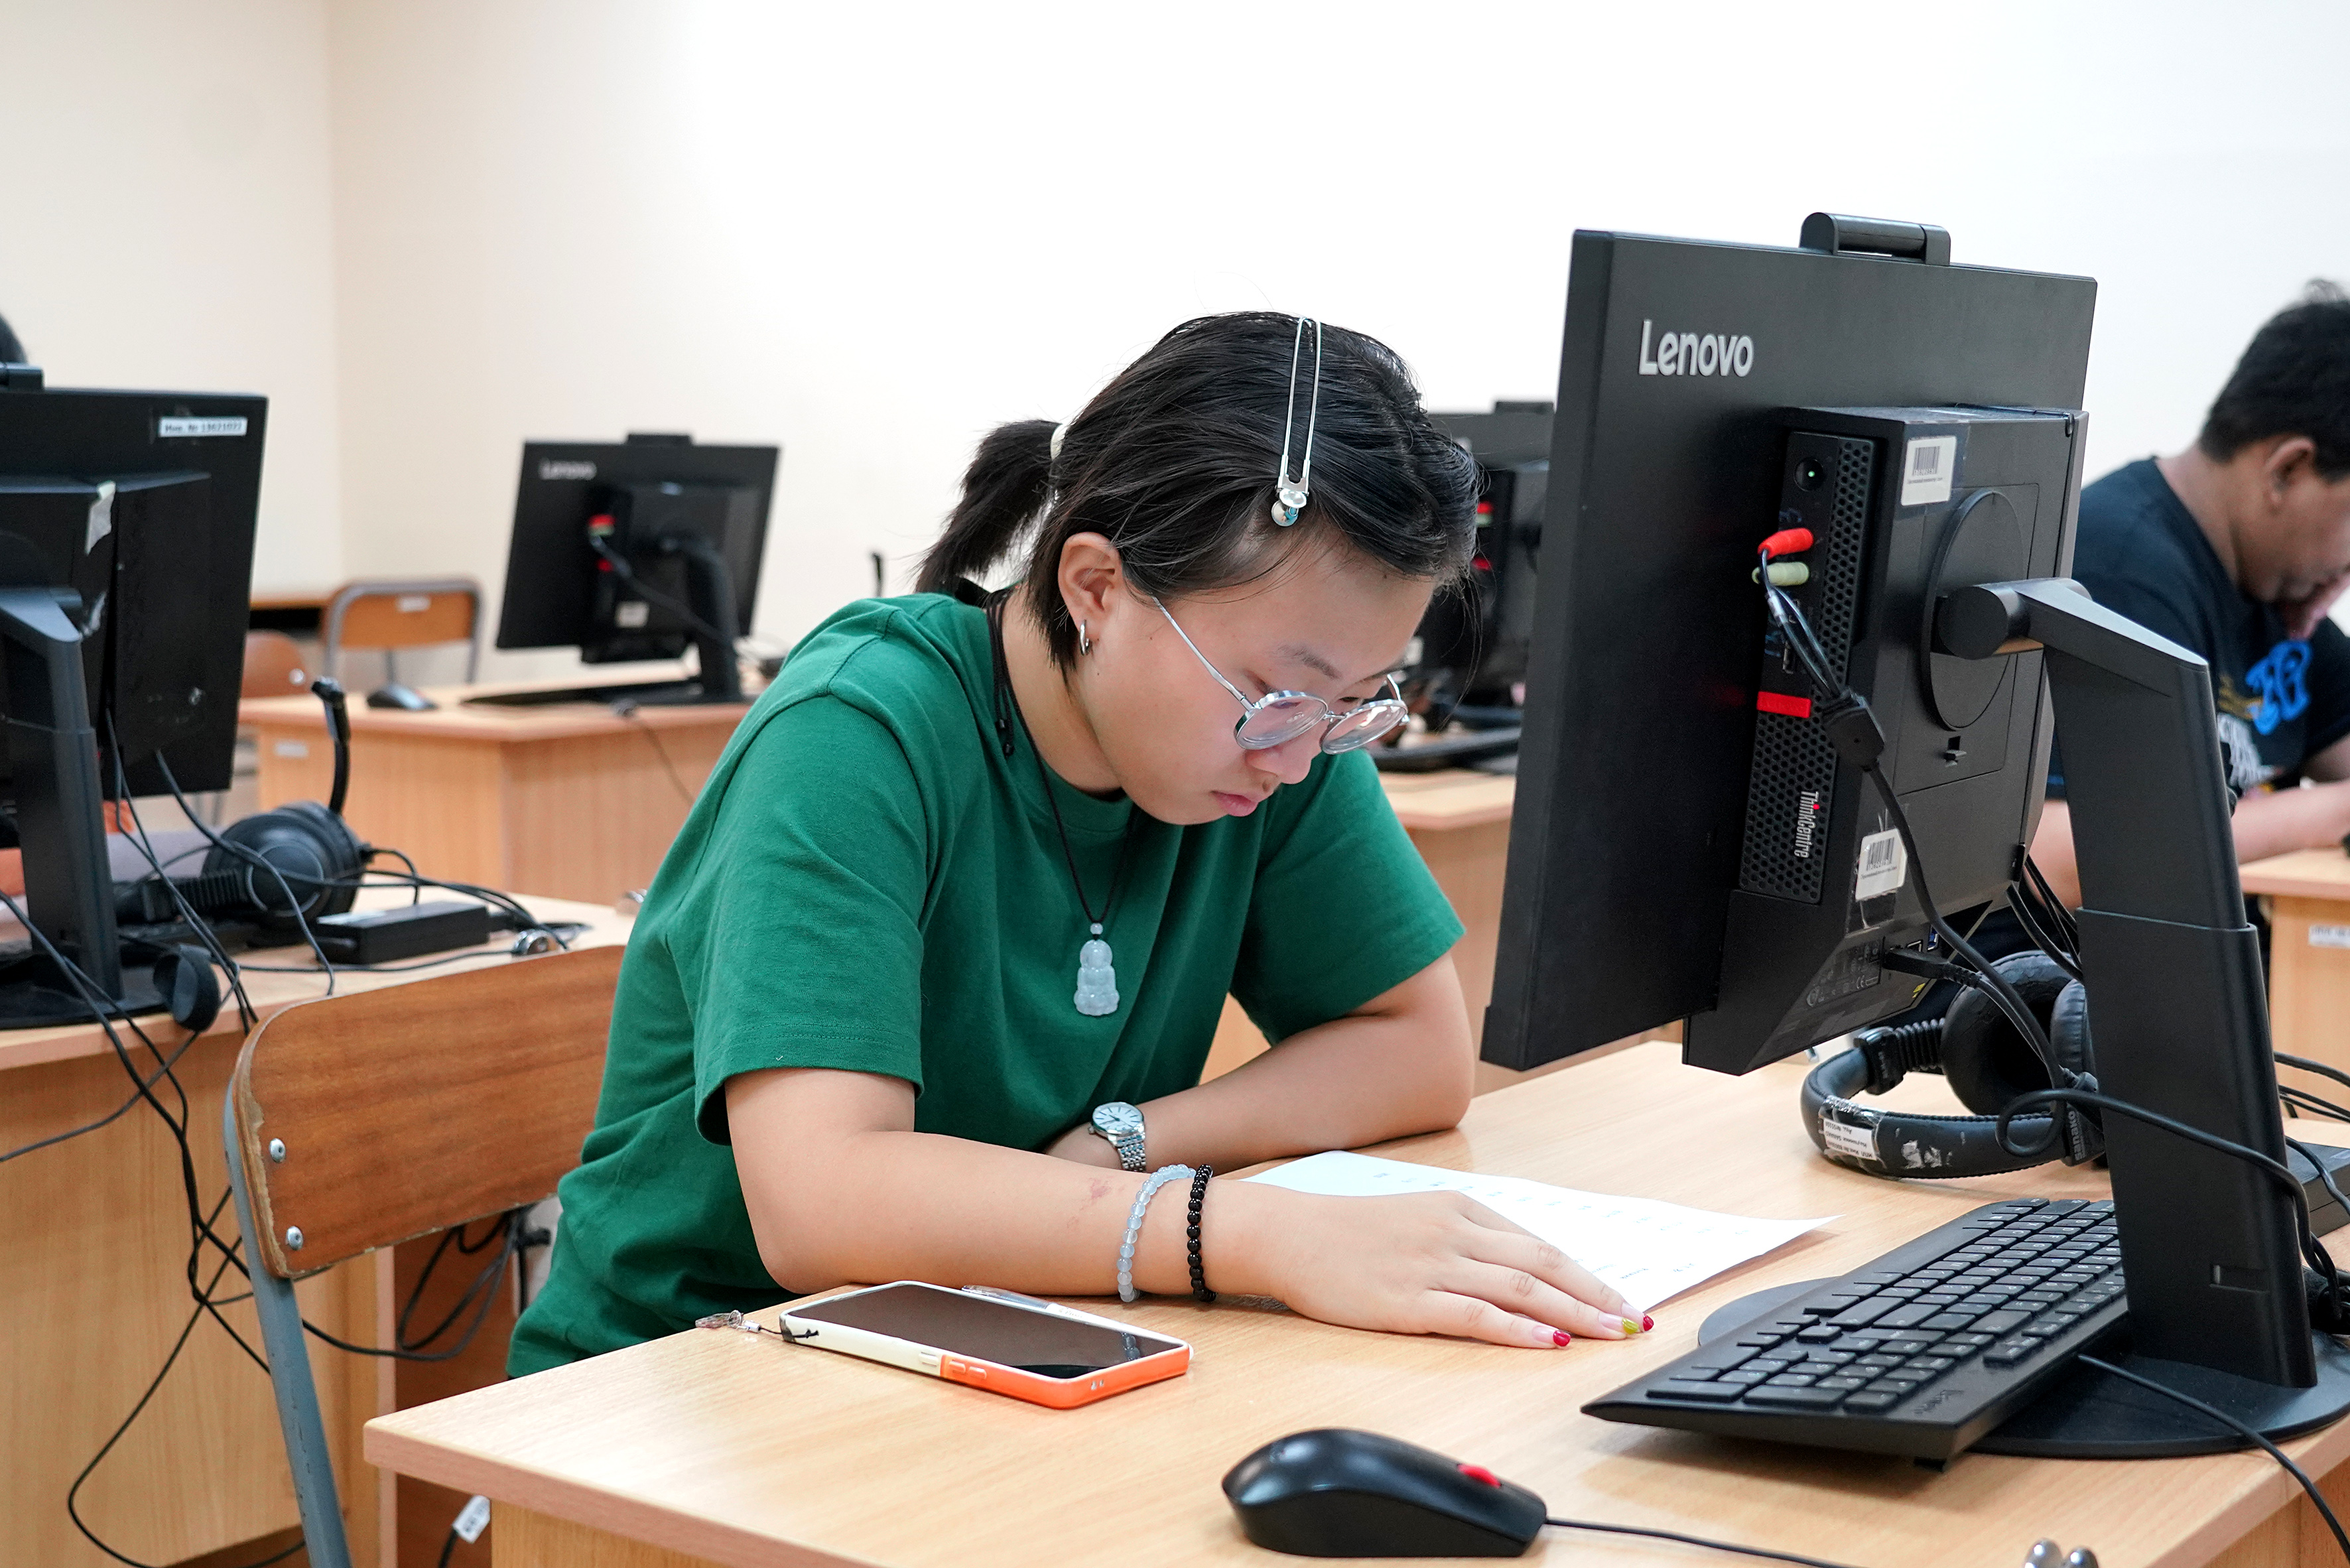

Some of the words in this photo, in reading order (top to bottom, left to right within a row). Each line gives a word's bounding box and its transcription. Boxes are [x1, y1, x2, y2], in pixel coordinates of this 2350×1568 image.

[1638, 318, 1754, 377] Lenovo
[1794, 791, 1820, 858] ThinkCentre
[2068, 1110, 2083, 1161] sanako
